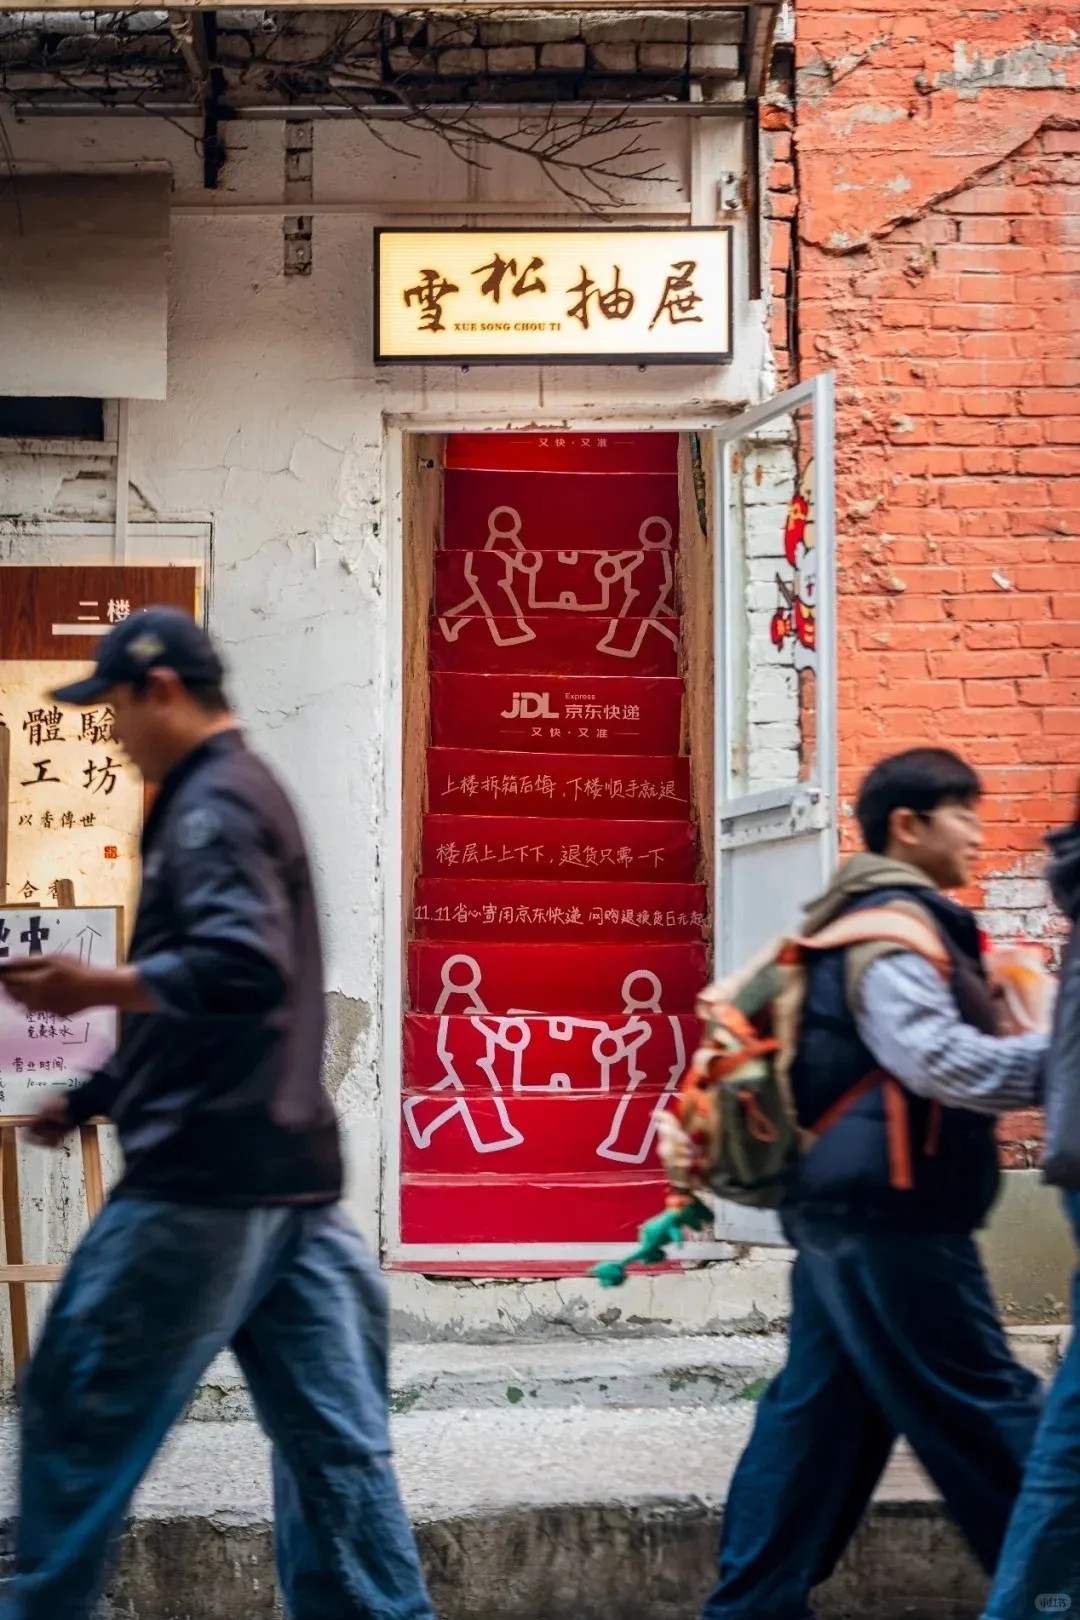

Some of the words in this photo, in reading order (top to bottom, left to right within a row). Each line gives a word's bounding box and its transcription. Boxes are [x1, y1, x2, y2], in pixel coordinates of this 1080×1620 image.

[454, 322, 477, 332] XUE
[480, 322, 511, 332] SONG
[514, 322, 546, 332] CHOU
[549, 322, 562, 332] TI
[77, 599, 131, 623] 二楼
[500, 691, 560, 719] JDL
[565, 692, 596, 701] Express
[565, 704, 641, 721] 京东快递
[0, 705, 119, 747] 體驗
[20, 756, 122, 795] 工坊
